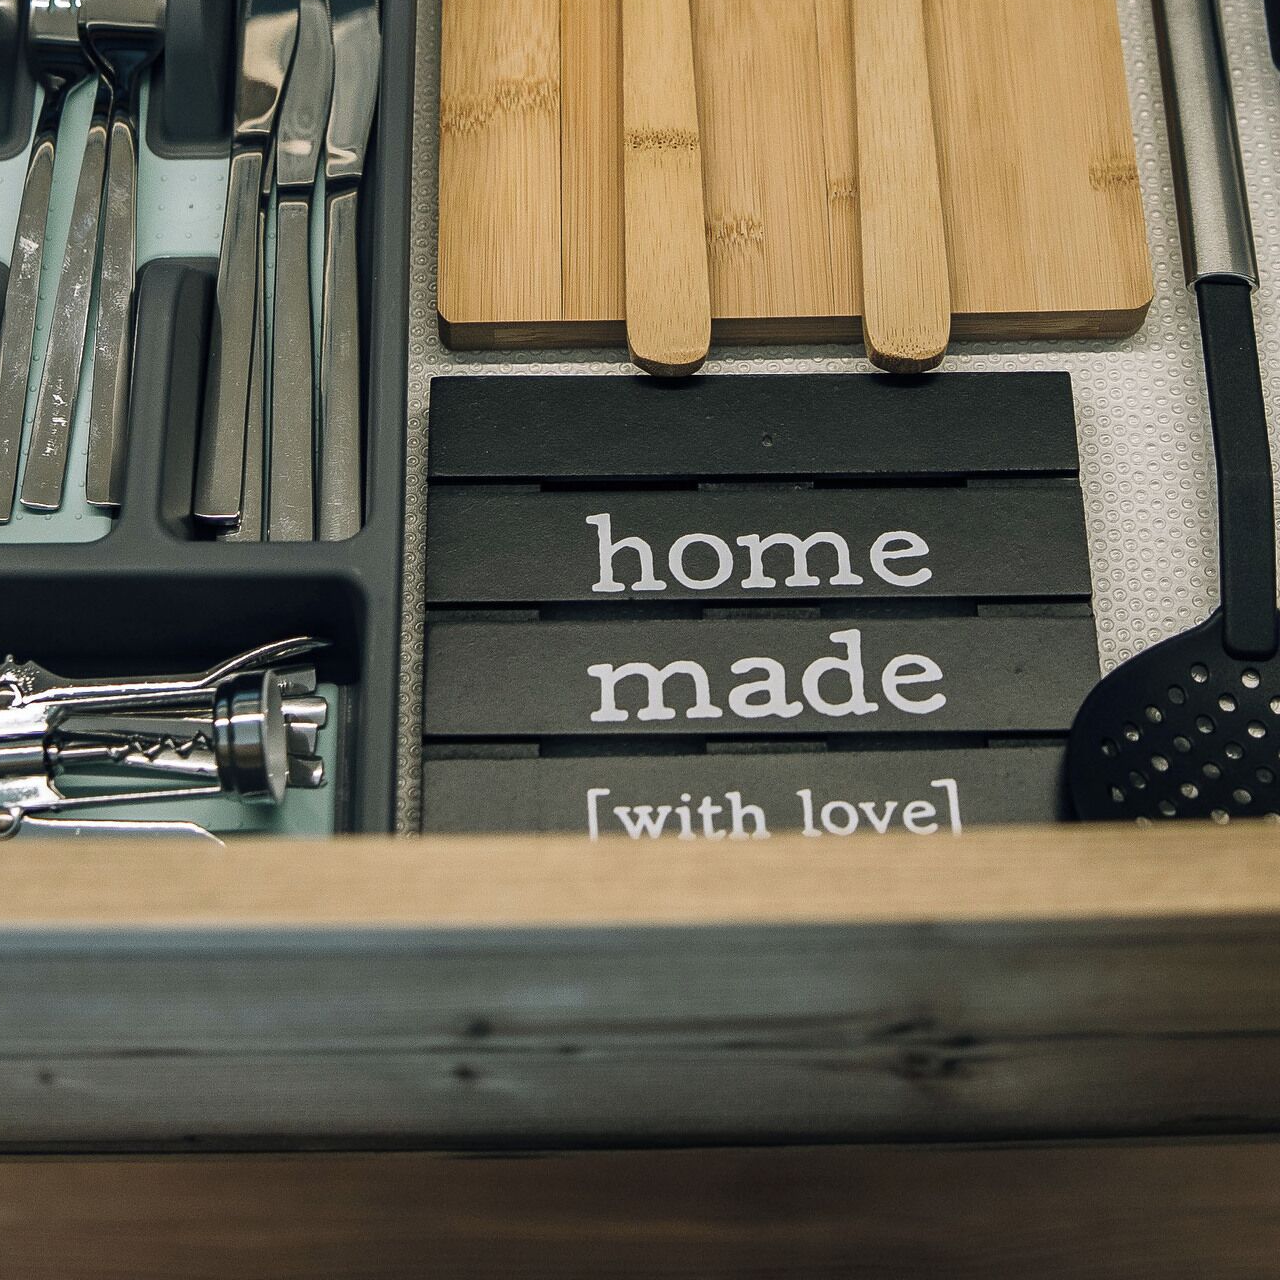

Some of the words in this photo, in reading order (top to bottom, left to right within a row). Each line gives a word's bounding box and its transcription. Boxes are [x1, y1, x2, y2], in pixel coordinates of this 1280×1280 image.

[585, 512, 933, 593] home
[586, 628, 947, 722] made
[586, 787, 771, 840] [with
[795, 778, 963, 837] love]
